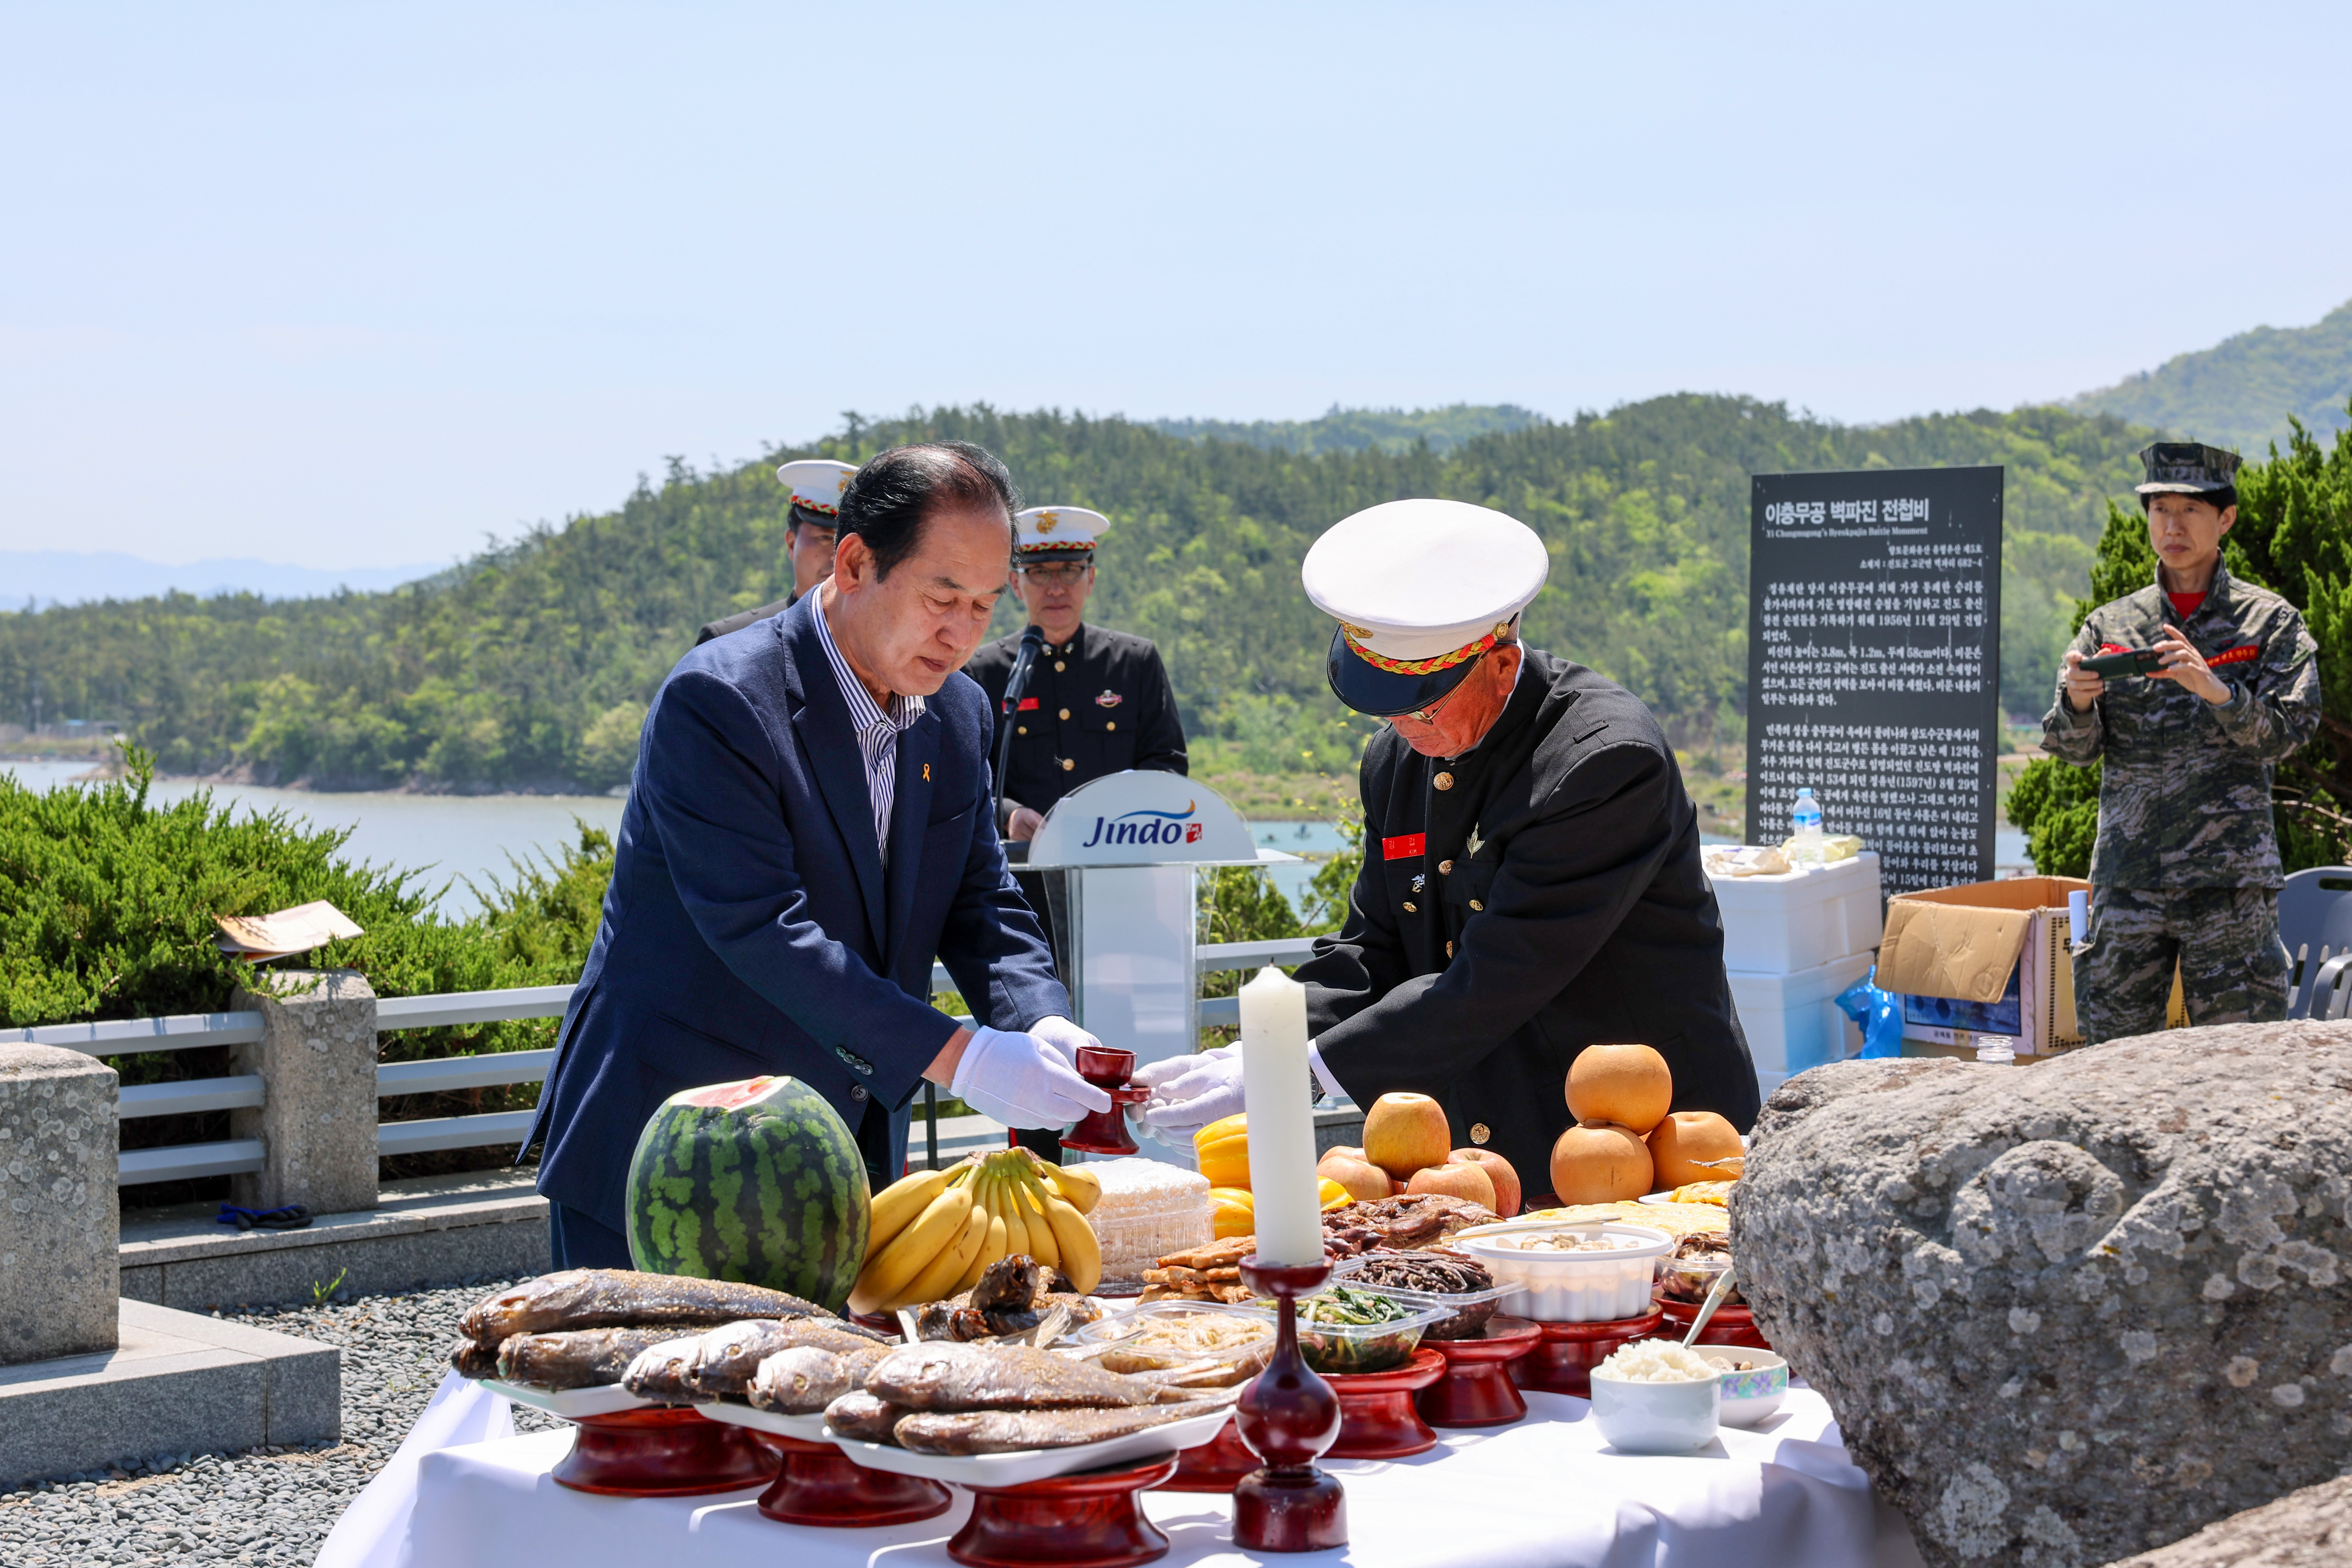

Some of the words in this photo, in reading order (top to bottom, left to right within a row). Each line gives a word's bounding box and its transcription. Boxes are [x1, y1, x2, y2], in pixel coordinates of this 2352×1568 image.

[1765, 502, 1826, 525] 이충무공
[1830, 500, 1877, 523] 벽파진
[1882, 498, 1929, 522] 전첩비
[1891, 526, 1928, 535] Monument
[1887, 558, 1909, 569] 진도군
[1769, 582, 1804, 595] 정유재란
[1808, 582, 1825, 595] 당시
[1829, 581, 1874, 595] 이충무공에
[1900, 581, 1919, 594] 가장
[1954, 580, 1984, 594] 승리를
[1943, 597, 1962, 610] 진도
[1964, 597, 1982, 610] 출신
[1879, 613, 1911, 627] 1956년
[1915, 613, 1935, 627] 11월
[1939, 613, 1960, 627] 29일
[1964, 613, 1982, 627] 건립
[1768, 645, 1792, 658] 비신의
[1955, 645, 1982, 660] 비문은
[1762, 661, 1778, 674] 시인
[1780, 661, 1812, 674] 이은상이
[1860, 662, 1877, 675] 진도
[1879, 662, 1896, 675] 출신
[1807, 677, 1831, 690] 군민의
[1859, 678, 1876, 691] 모아
[1877, 678, 1886, 691] 이
[1936, 679, 1954, 692] 비문
[1955, 679, 1980, 692] 내용의
[1761, 692, 1786, 705] 일부는
[1788, 692, 1814, 706] 다음과
[1766, 723, 1790, 736] 민족의
[1811, 724, 1844, 738] 충무공이
[1761, 739, 1785, 752] 무거운
[1806, 740, 1822, 753] 다시
[1824, 741, 1849, 754] 지고서
[1919, 743, 1937, 757] 남은
[1939, 744, 1947, 757] 배
[1825, 756, 1867, 770] 진도군수로
[1760, 770, 1785, 784] 이르니
[1807, 772, 1824, 785] 공이
[1826, 773, 1847, 786] 53세
[1849, 773, 1866, 787] 되던
[1939, 777, 1954, 791] 8월
[1958, 778, 1979, 791] 29일
[1778, 787, 1821, 801] 조정는
[1969, 795, 1978, 808] 이
[1873, 807, 1892, 820] 16일
[1894, 808, 1911, 821] 동안
[1941, 810, 1949, 823] 비
[1952, 810, 1978, 824] 내리고
[1083, 817, 1182, 847] Jindo
[1896, 824, 1905, 836] 배
[1950, 827, 1977, 840] 눈물도
[1389, 840, 1395, 849] 김
[1409, 838, 1415, 846] 갑
[1759, 833, 1791, 848] 지으셨
[1882, 856, 1909, 869] 들어와
[1911, 858, 1939, 871] 우리를
[1901, 874, 1928, 887] 15일에
